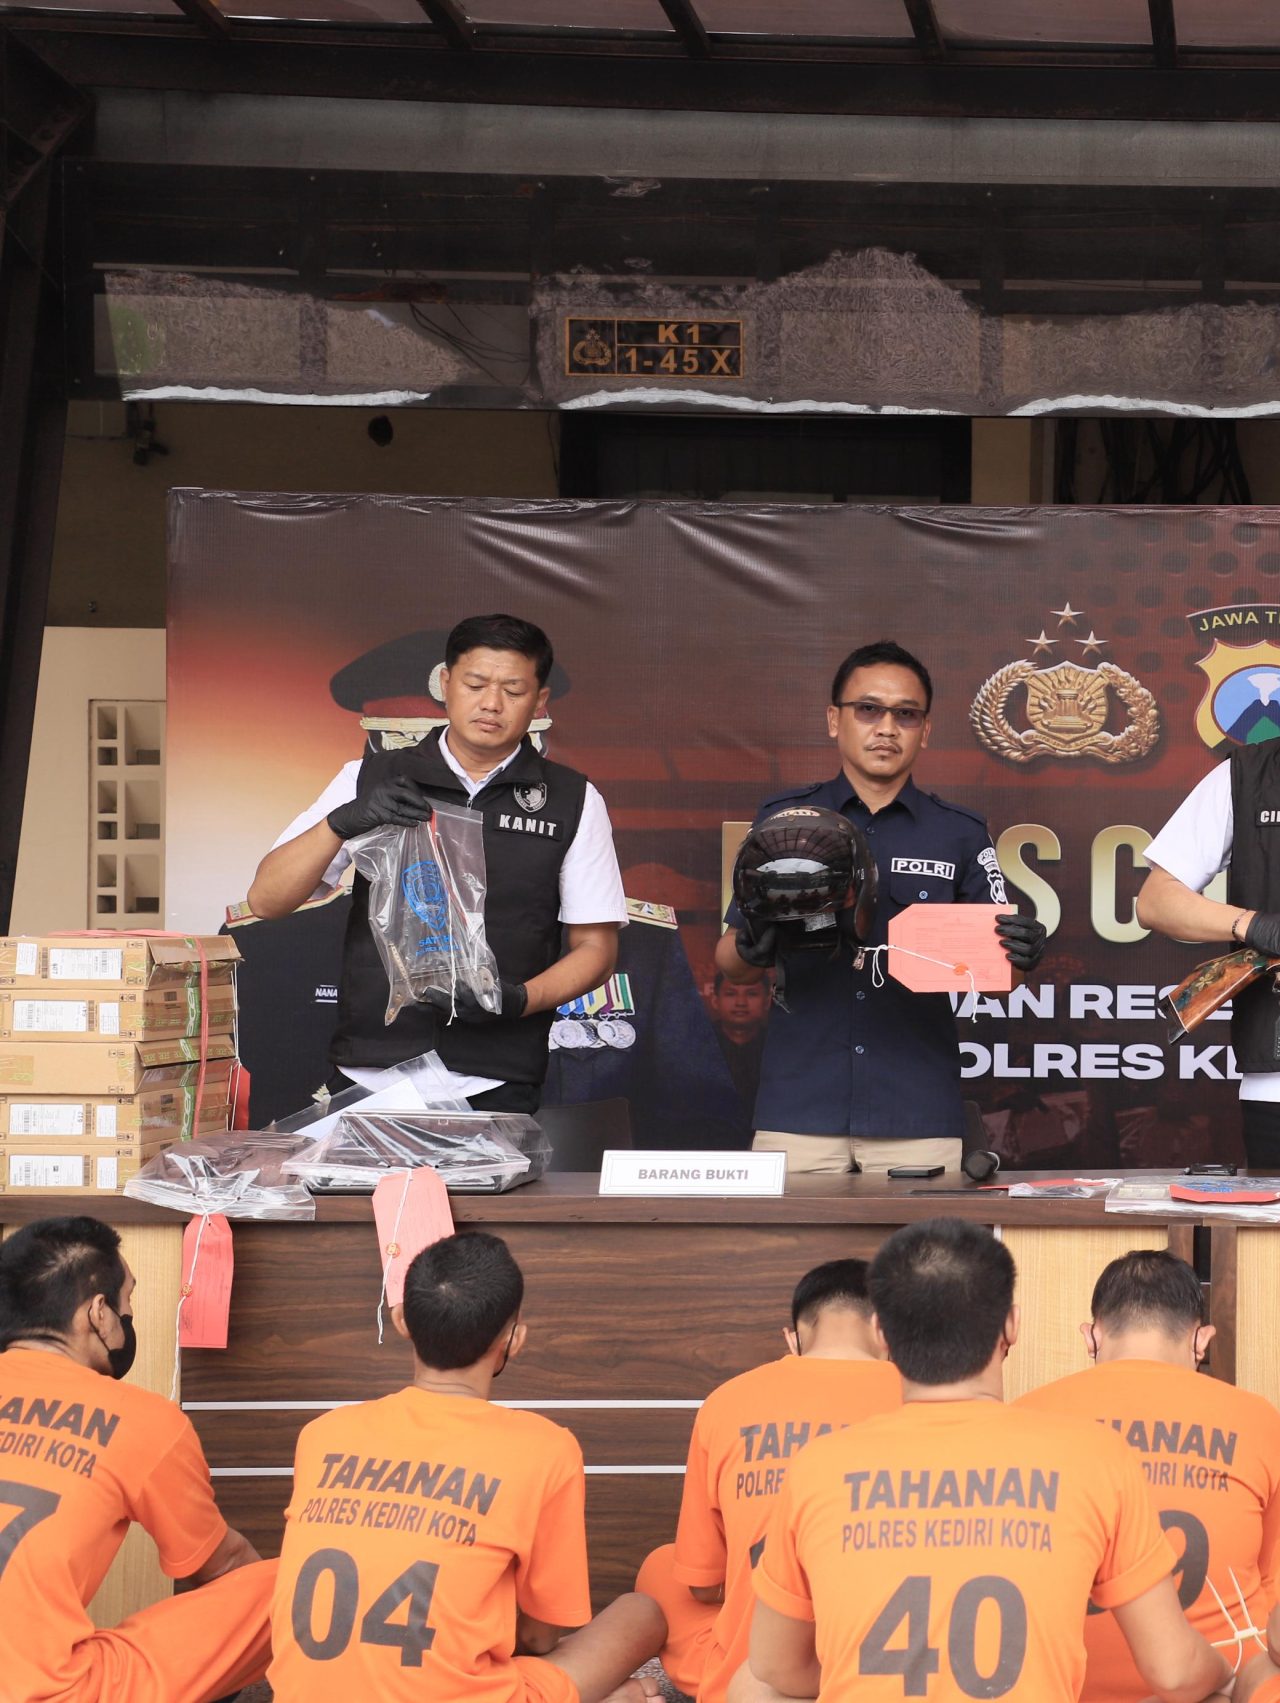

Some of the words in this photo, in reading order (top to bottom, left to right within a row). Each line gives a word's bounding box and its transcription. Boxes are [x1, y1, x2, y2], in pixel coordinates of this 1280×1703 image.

[1199, 611, 1259, 632] JAWA
[499, 814, 557, 836] KANIT
[896, 860, 951, 877] POLRI
[637, 1168, 702, 1180] BARANG
[705, 1168, 749, 1180] BUKTI
[0, 1395, 121, 1447] ANAN
[1096, 1419, 1237, 1466] ANAN
[44, 1438, 97, 1479] KOTA
[1183, 1465, 1229, 1492] KOTA
[317, 1453, 501, 1516] TAHANAN
[844, 1468, 1059, 1513] TAHANAN
[299, 1498, 358, 1527] POLRES
[362, 1502, 430, 1533] KEDIRI
[431, 1511, 478, 1547] KOTA
[842, 1520, 917, 1553] POLRES
[924, 1518, 993, 1548] KEDIRI
[1001, 1517, 1053, 1553] KOTA
[291, 1547, 441, 1668] 04
[858, 1575, 1028, 1699] 40
